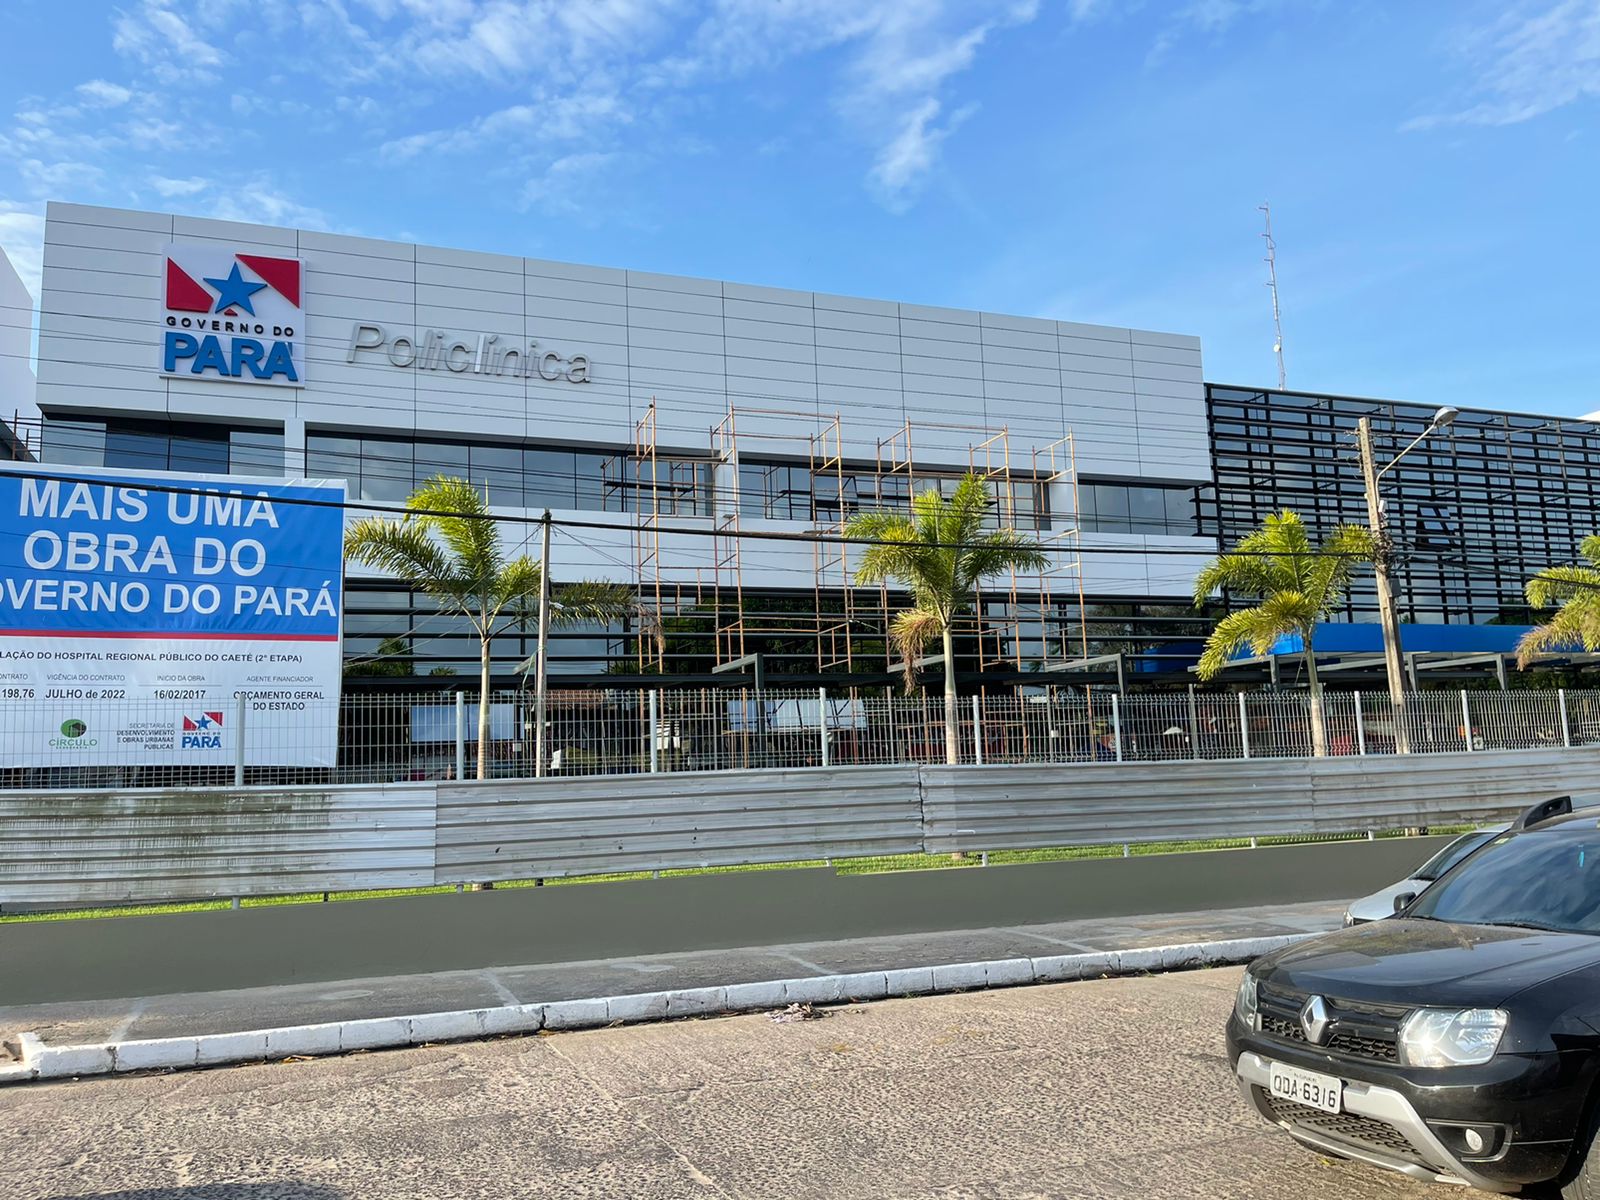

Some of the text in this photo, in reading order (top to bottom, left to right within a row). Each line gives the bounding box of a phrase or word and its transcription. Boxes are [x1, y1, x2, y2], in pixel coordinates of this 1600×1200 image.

[166, 316, 294, 337] GOVERNO DO
[164, 331, 299, 382] PARÁ
[346, 322, 592, 384] Policlínica
[19, 477, 280, 529] MAIS UMA
[24, 529, 267, 577] OBRA DO
[0, 577, 337, 617] VERNO DO PARÁ
[37, 651, 52, 660] DO
[54, 651, 103, 661] HOSPITAL
[105, 653, 157, 661] REGIONAL
[159, 651, 201, 662] PÚBLICO
[204, 653, 219, 662] DO
[221, 652, 253, 662] CAETÉ
[269, 655, 303, 664] ETAPA)
[79, 674, 89, 682] DO
[90, 674, 126, 682] CONTRATO
[2, 688, 35, 700] 198,76
[45, 688, 126, 699] JULHO de 2022
[153, 689, 206, 700] 16/02/2017
[293, 691, 325, 701] GERAL
[253, 702, 306, 711] DO ESTADO
[181, 736, 222, 748] PARÁ
